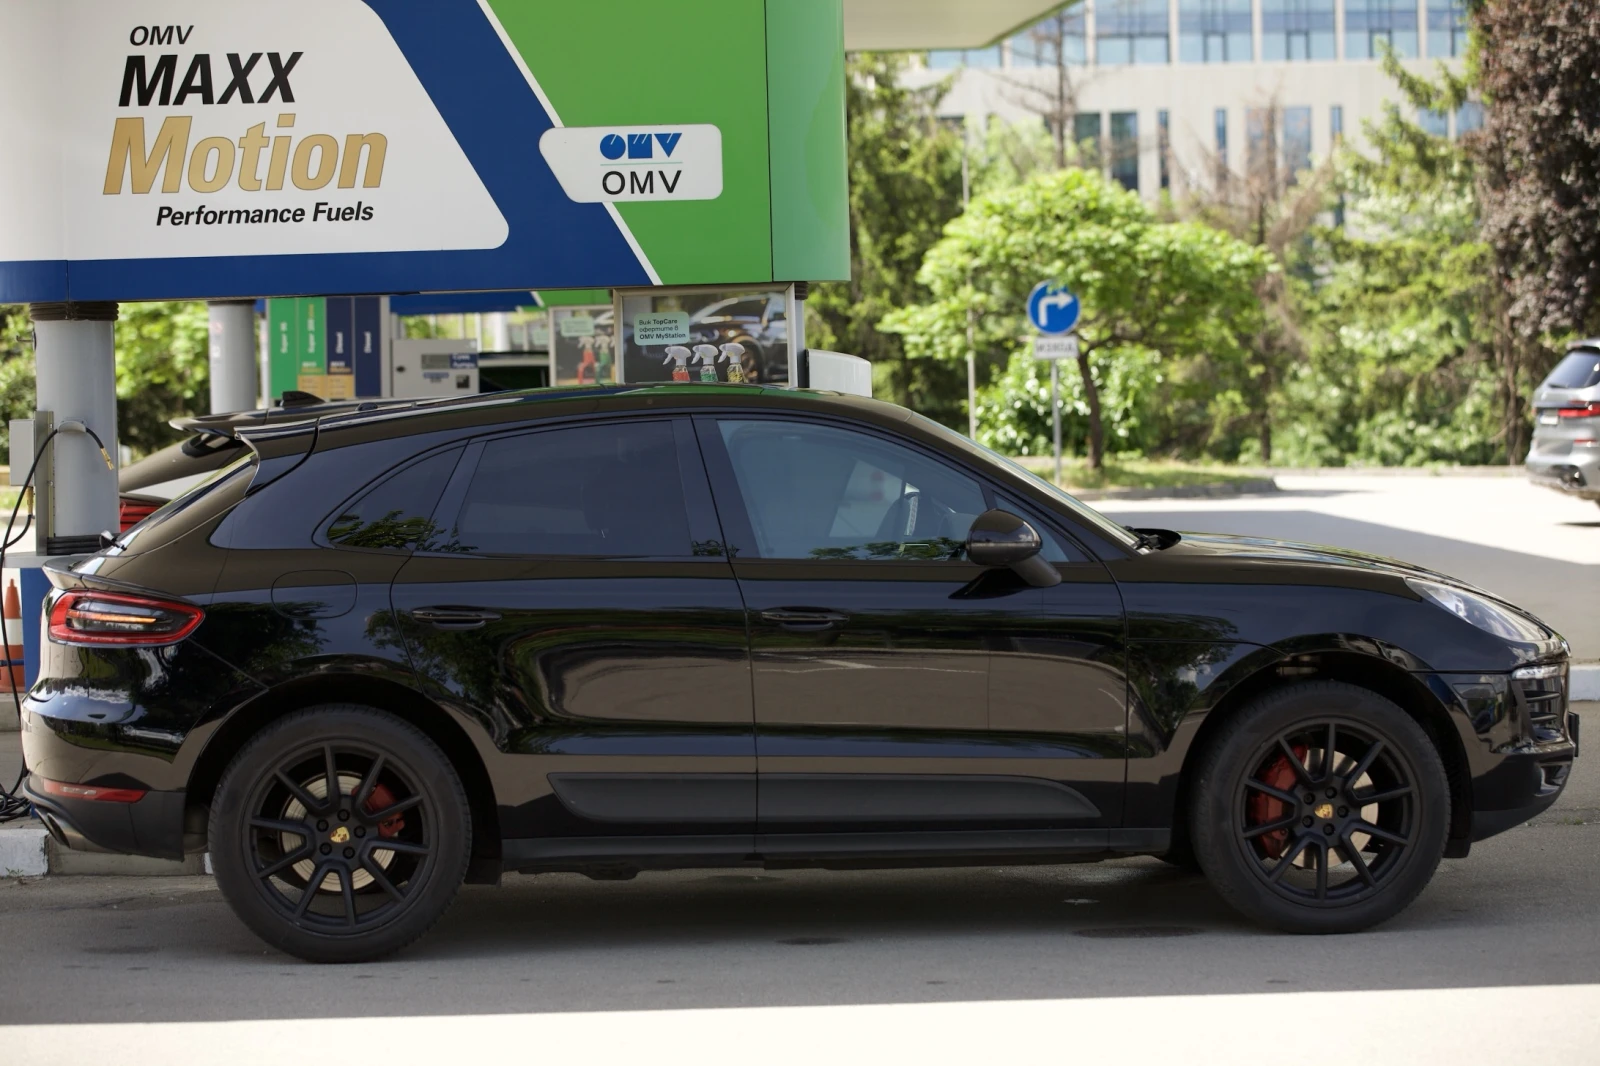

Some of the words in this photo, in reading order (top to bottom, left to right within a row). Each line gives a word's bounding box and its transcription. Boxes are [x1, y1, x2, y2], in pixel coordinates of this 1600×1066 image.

[129, 25, 194, 46] OMV
[118, 51, 304, 107] MAXX
[102, 113, 388, 195] Motion
[602, 169, 682, 195] OMV
[156, 205, 305, 226] Performance
[312, 201, 374, 222] Fuels
[653, 318, 678, 326] TopCare
[655, 332, 687, 341] MyStation
